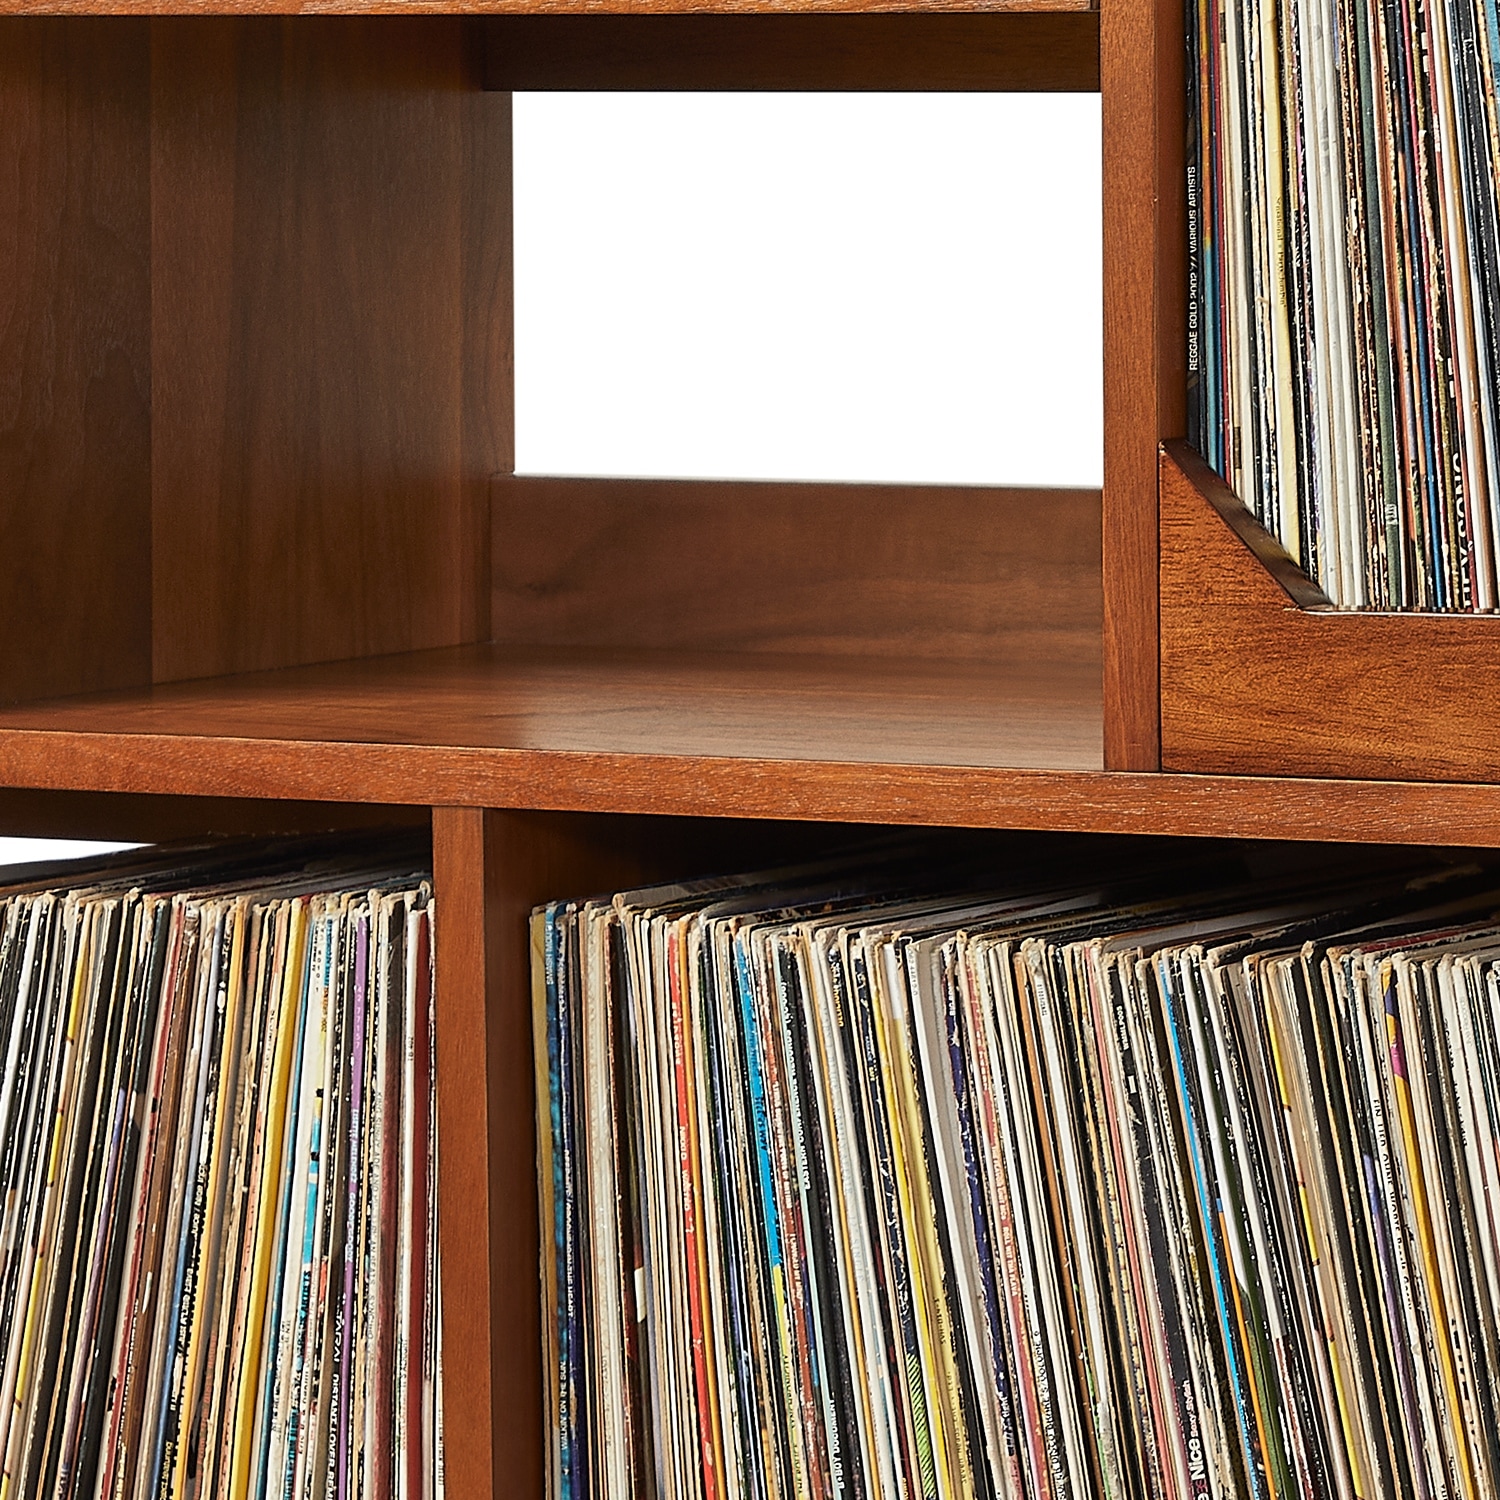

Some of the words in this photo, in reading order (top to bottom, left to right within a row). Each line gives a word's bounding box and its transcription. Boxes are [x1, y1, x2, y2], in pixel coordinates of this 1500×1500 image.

[1187, 166, 1196, 206] ARTISTS
[1188, 209, 1197, 252] VARIOUS
[1188, 301, 1197, 328] GOLD
[1188, 331, 1198, 370] REGGAE
[544, 953, 554, 985] SMASH
[990, 1144, 1000, 1158] THE
[1002, 1226, 1011, 1245] ROLL
[1004, 1245, 1013, 1259] WIT
[1006, 1259, 1015, 1273] THA
[1008, 1273, 1018, 1296] FLAVA
[559, 1399, 567, 1413] ON
[1185, 1436, 1205, 1480] Nice
